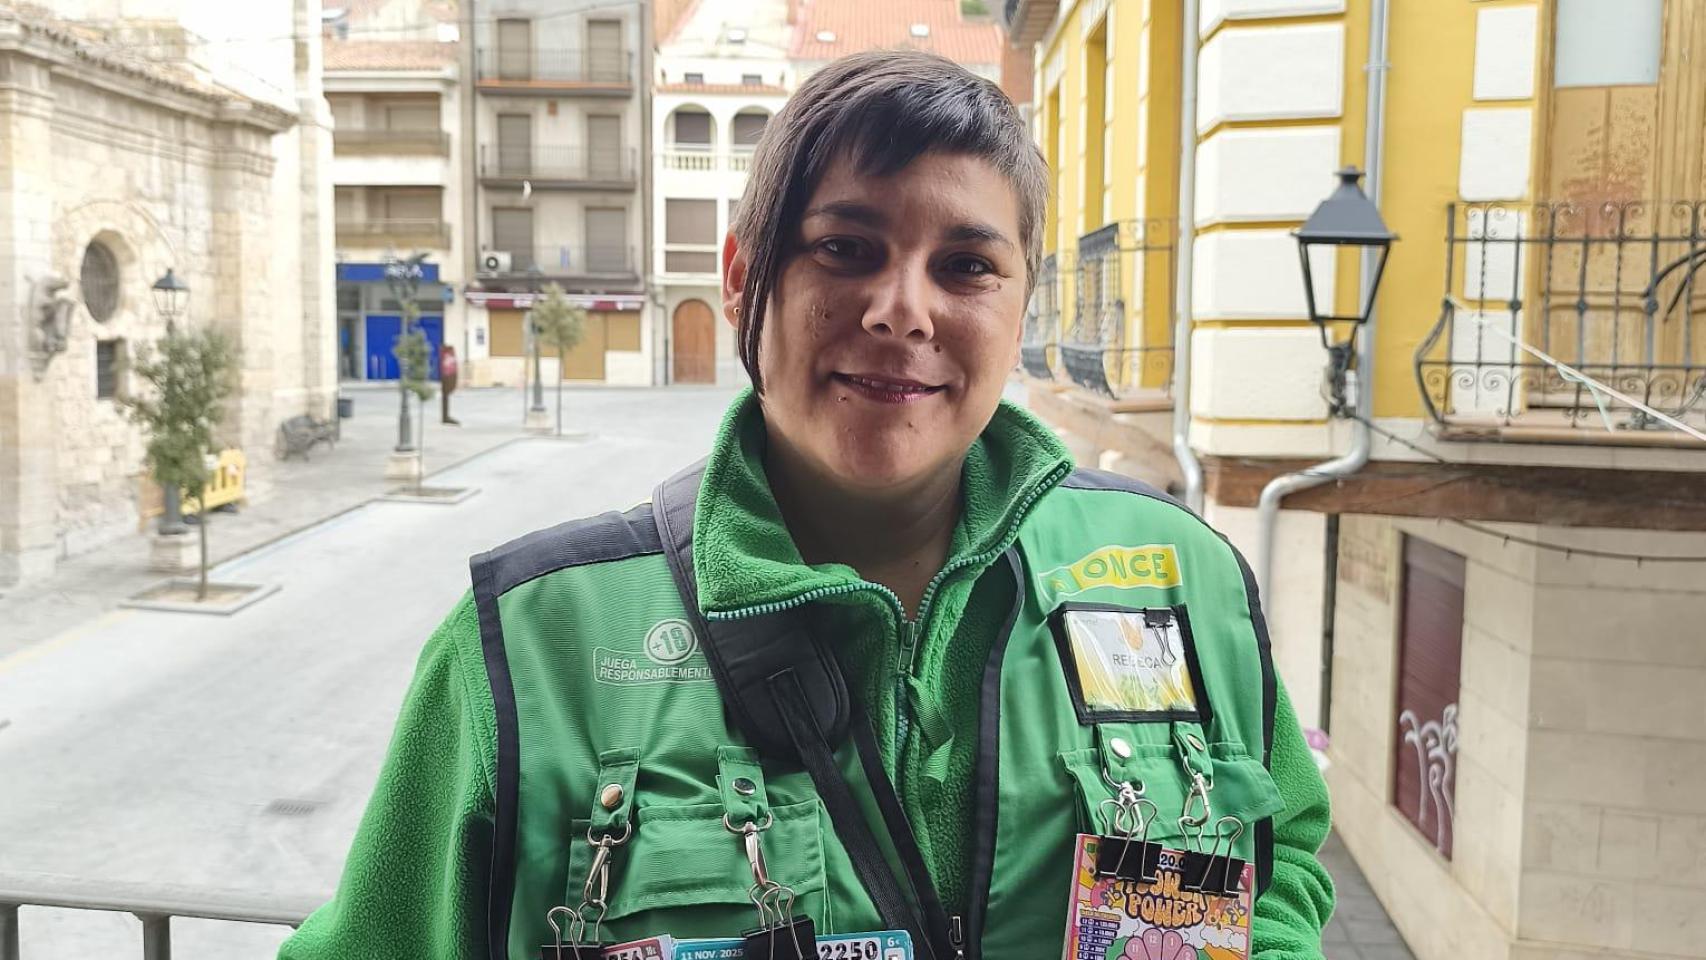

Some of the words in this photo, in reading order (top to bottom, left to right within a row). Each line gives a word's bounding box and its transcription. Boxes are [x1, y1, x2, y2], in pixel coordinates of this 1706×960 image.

[1083, 553, 1169, 580] ONCE
[652, 627, 689, 655] +18
[600, 656, 638, 670] JUEGA
[1128, 893, 1203, 927] POWER
[681, 952, 692, 960] 11
[694, 950, 718, 960] NOV.
[720, 948, 744, 958] 2025
